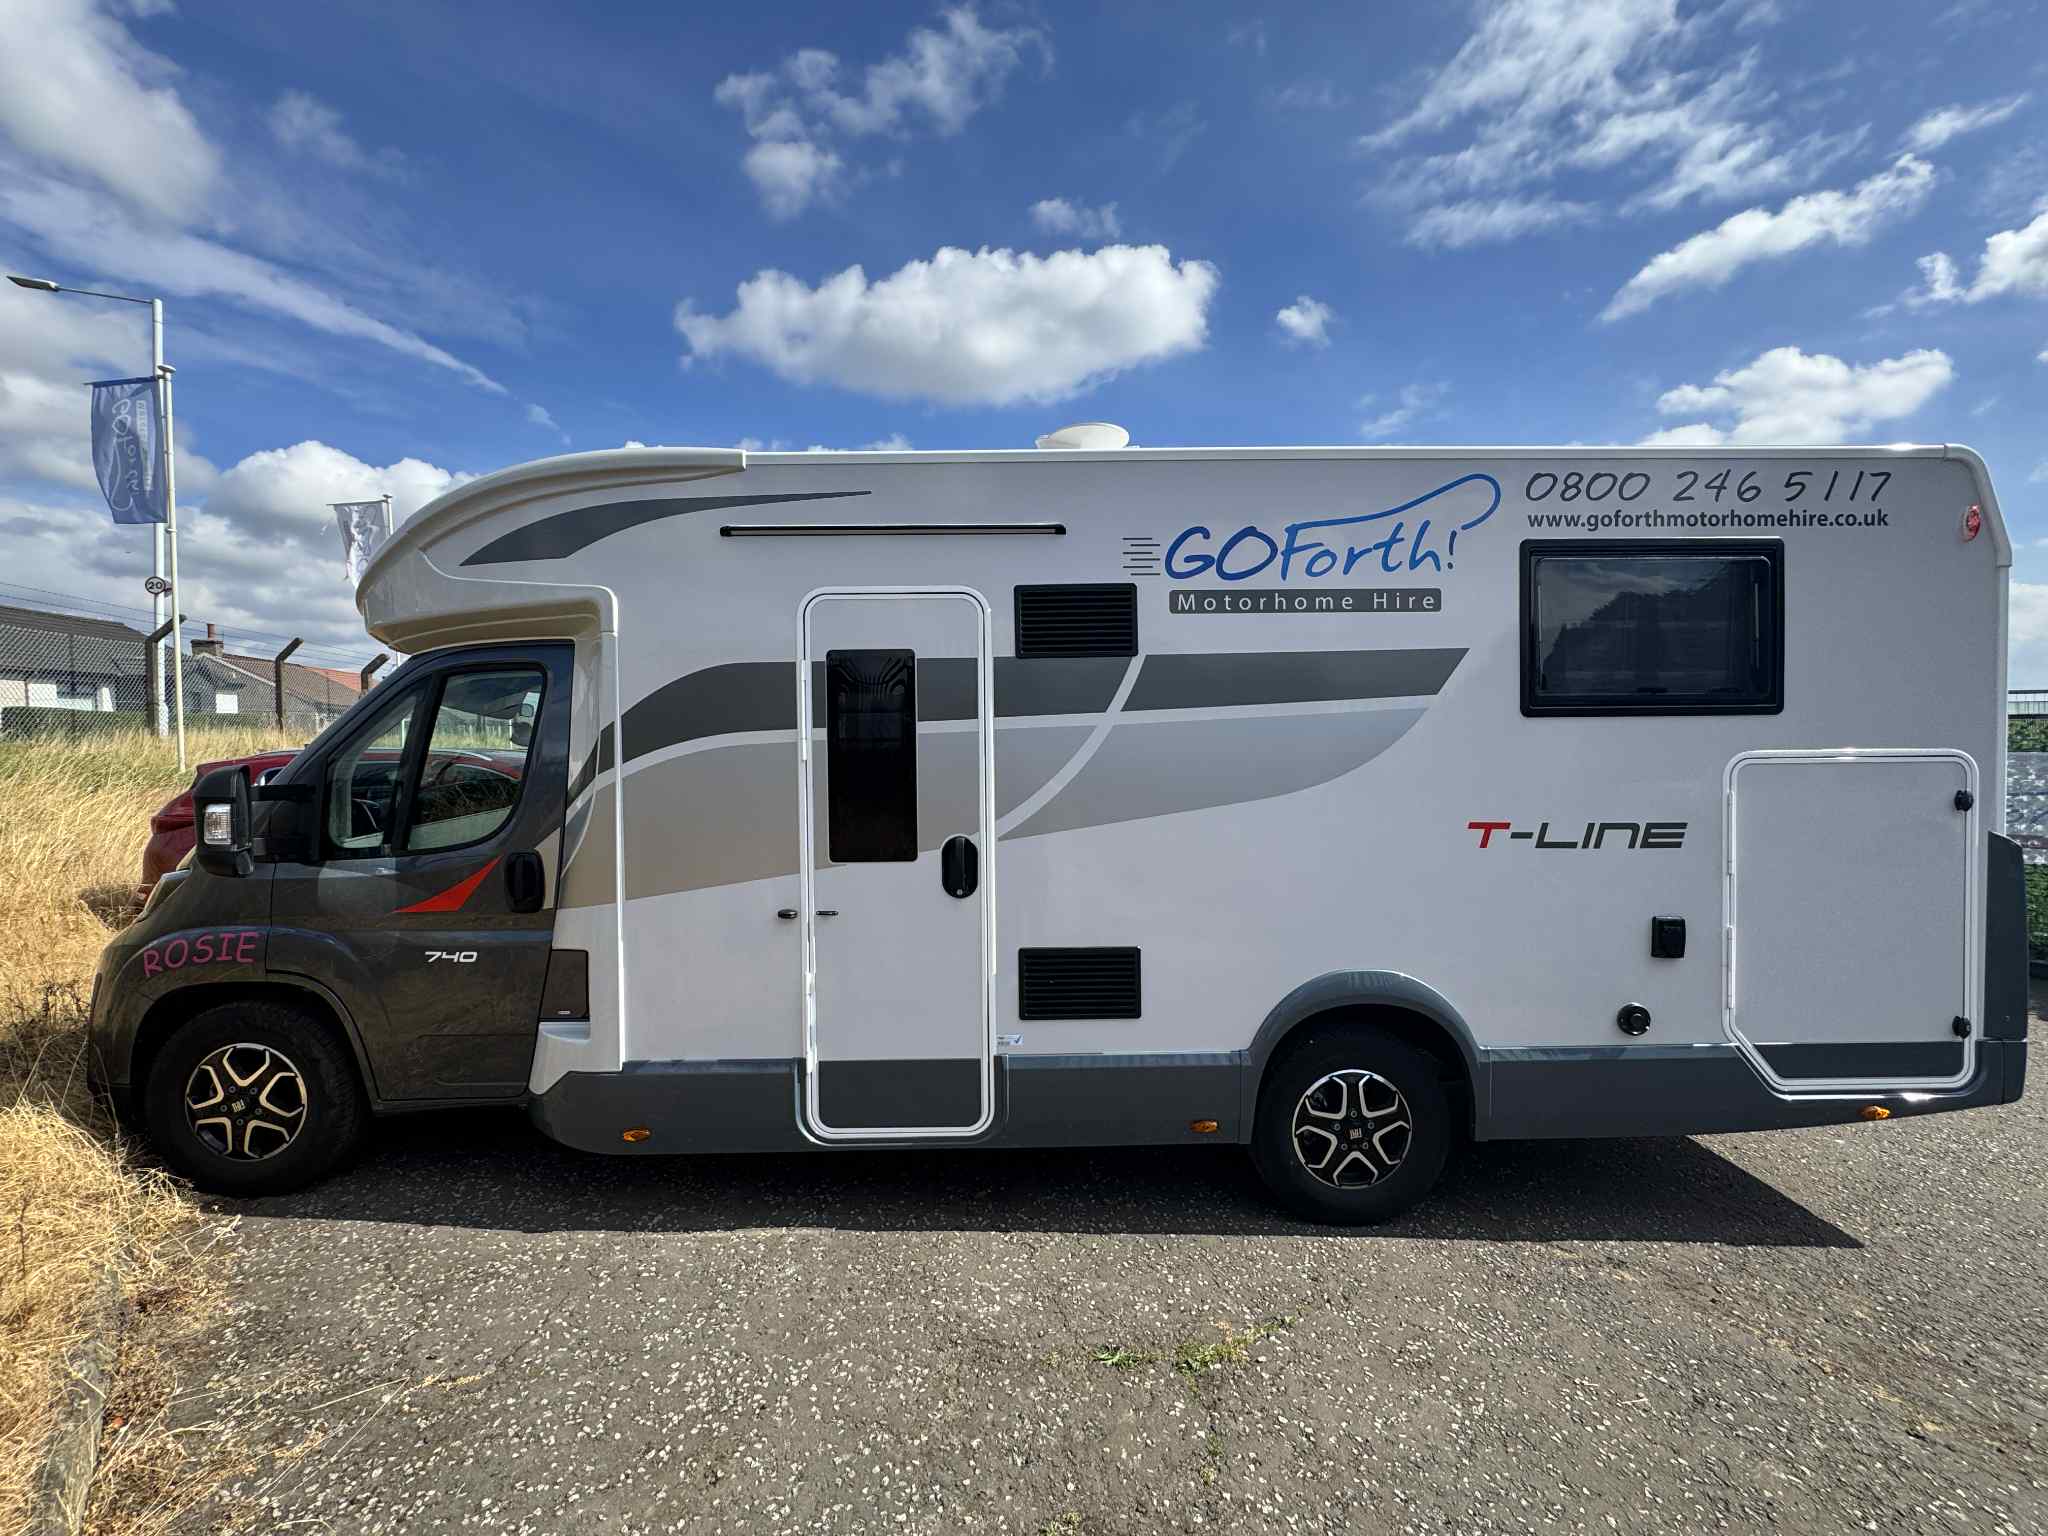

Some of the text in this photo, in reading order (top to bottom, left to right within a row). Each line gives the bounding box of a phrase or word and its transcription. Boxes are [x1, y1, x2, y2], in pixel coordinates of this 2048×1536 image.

[1525, 469, 1892, 502] 0800 246 5117
[1527, 509, 1889, 531] www.goforthmotorhomehire.co.uk
[148, 581, 163, 590] 20
[1177, 591, 1435, 611] Motorhome Hire
[1467, 822, 1688, 849] T-LINE
[143, 931, 258, 977] ROSIE
[424, 951, 478, 963] 740
